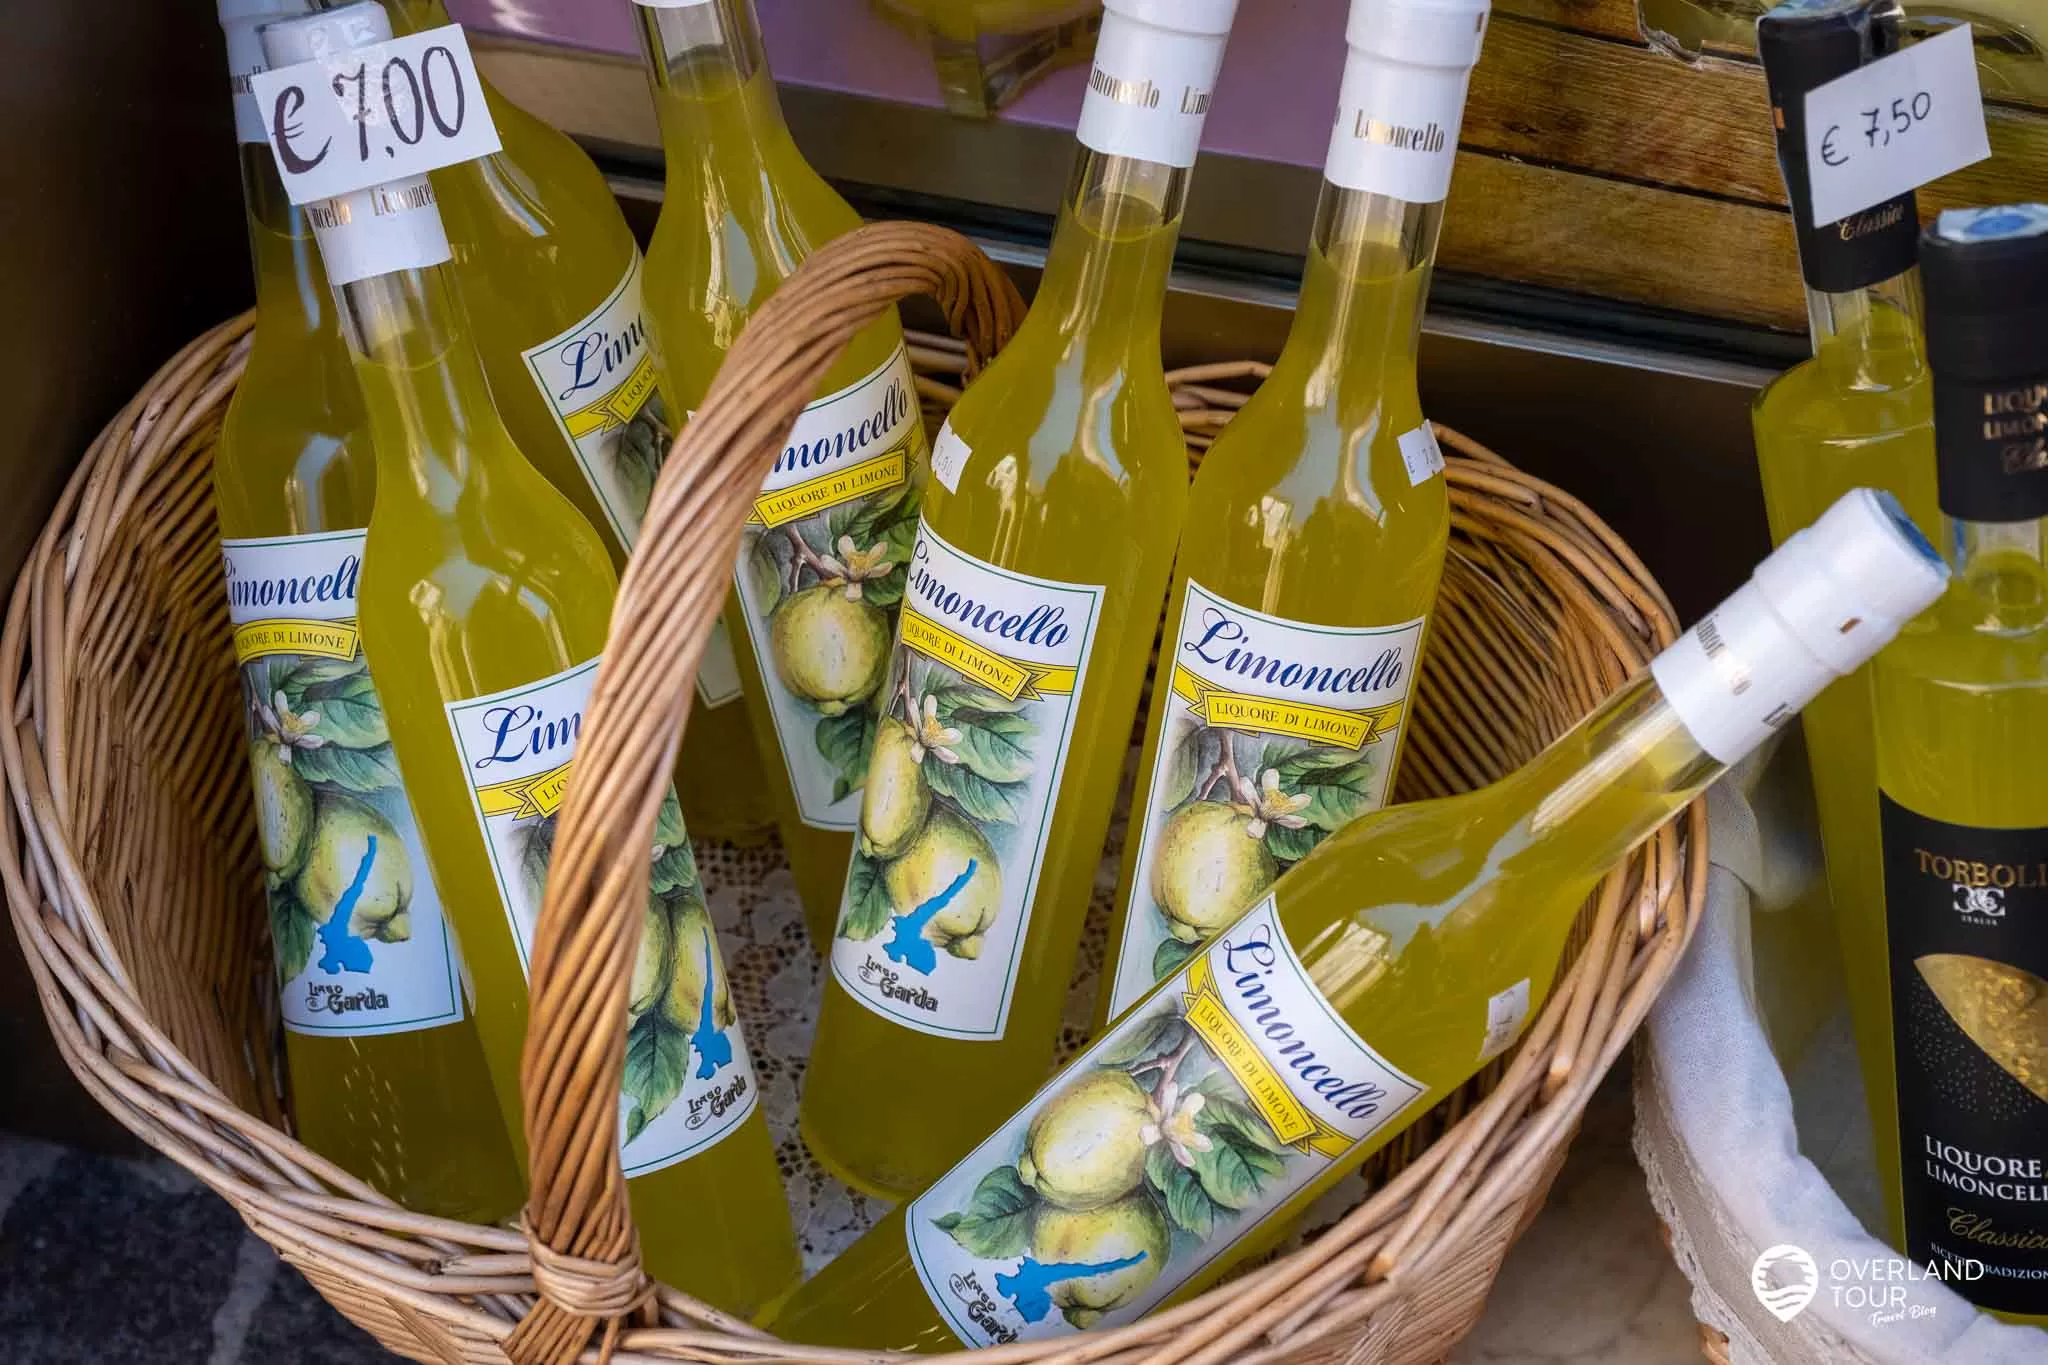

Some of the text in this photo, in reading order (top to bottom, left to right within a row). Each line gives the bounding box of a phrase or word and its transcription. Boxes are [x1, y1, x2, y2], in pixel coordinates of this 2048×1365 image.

[271, 86, 332, 175] €
[1354, 108, 1445, 153] Lioncello
[1821, 92, 1931, 167] € 7,50
[767, 463, 899, 516] LIQUORE DI LIMONE
[273, 631, 285, 644] DI
[289, 631, 344, 650] LIMONE
[906, 619, 1014, 688] LIQUORE DI LIMONE
[1184, 607, 1403, 693] Limoncello
[1215, 701, 1360, 738] LIQUORE DI LIMONE
[328, 987, 389, 1015] Garda
[880, 976, 938, 1012] Garda
[1222, 923, 1387, 1119] Limoncello
[1199, 1004, 1299, 1133] LIQUORE DI LIMONE
[1926, 1134, 2043, 1178] LIQUORE
